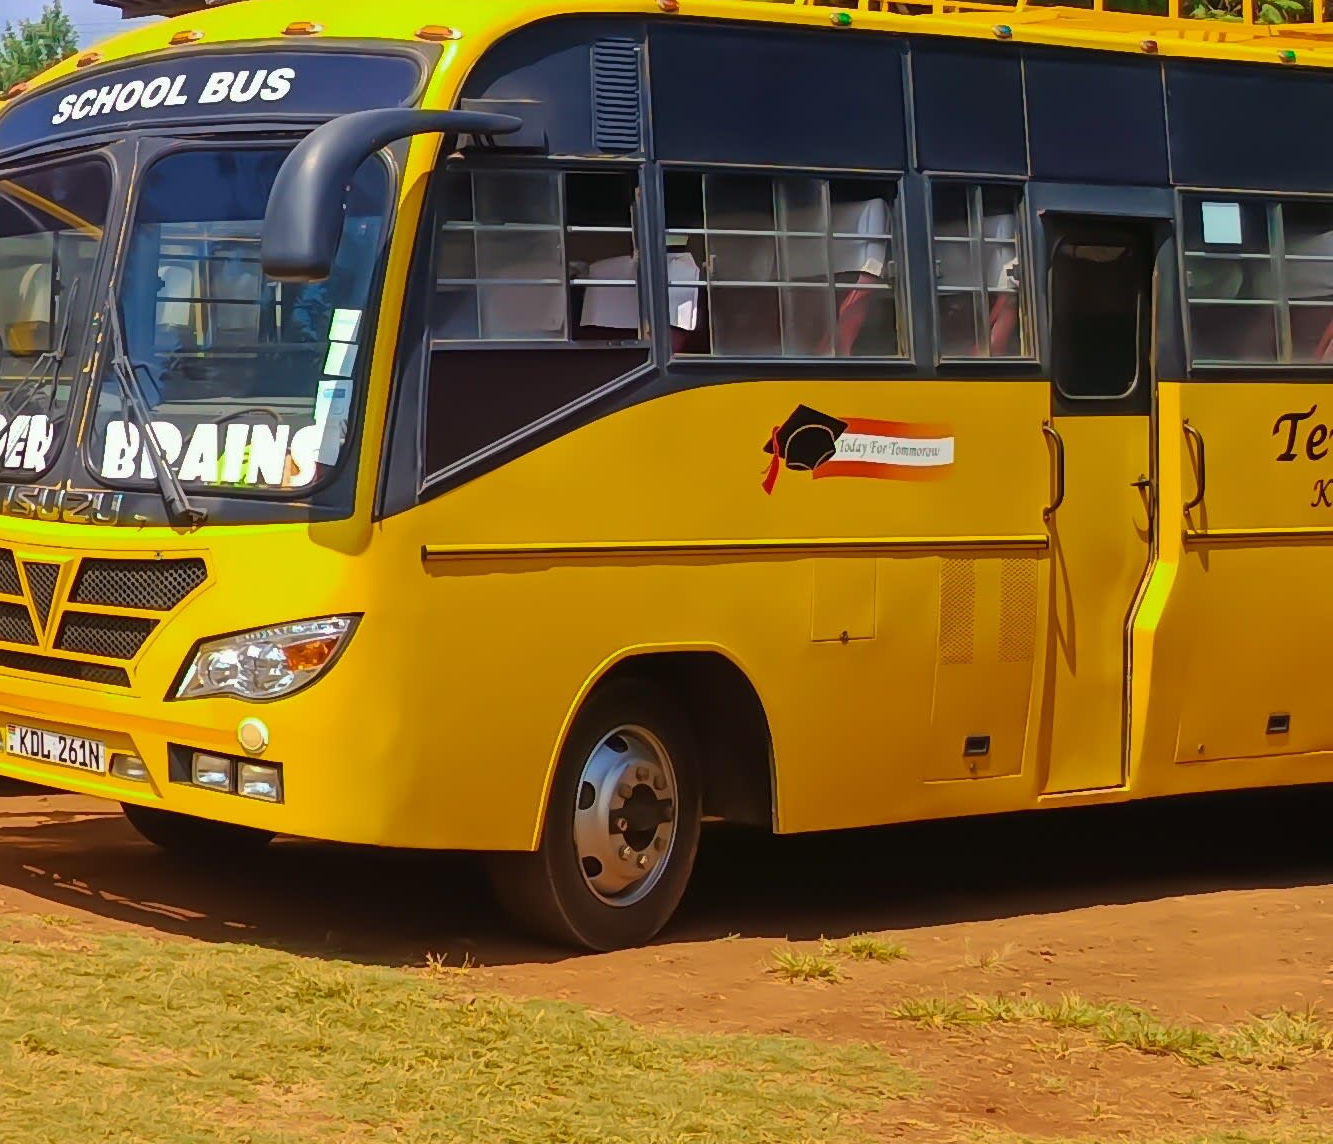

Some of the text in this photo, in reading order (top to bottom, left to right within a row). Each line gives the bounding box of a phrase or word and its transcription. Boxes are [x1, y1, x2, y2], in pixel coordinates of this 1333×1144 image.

[52, 67, 296, 125] SCHOOL BUS
[101, 420, 318, 487] BRAINS
[839, 438, 868, 458] Today
[869, 440, 888, 454] For
[1272, 404, 1333, 462] Te
[2, 485, 123, 526] ISUZU
[19, 727, 100, 770] KDL 261N
